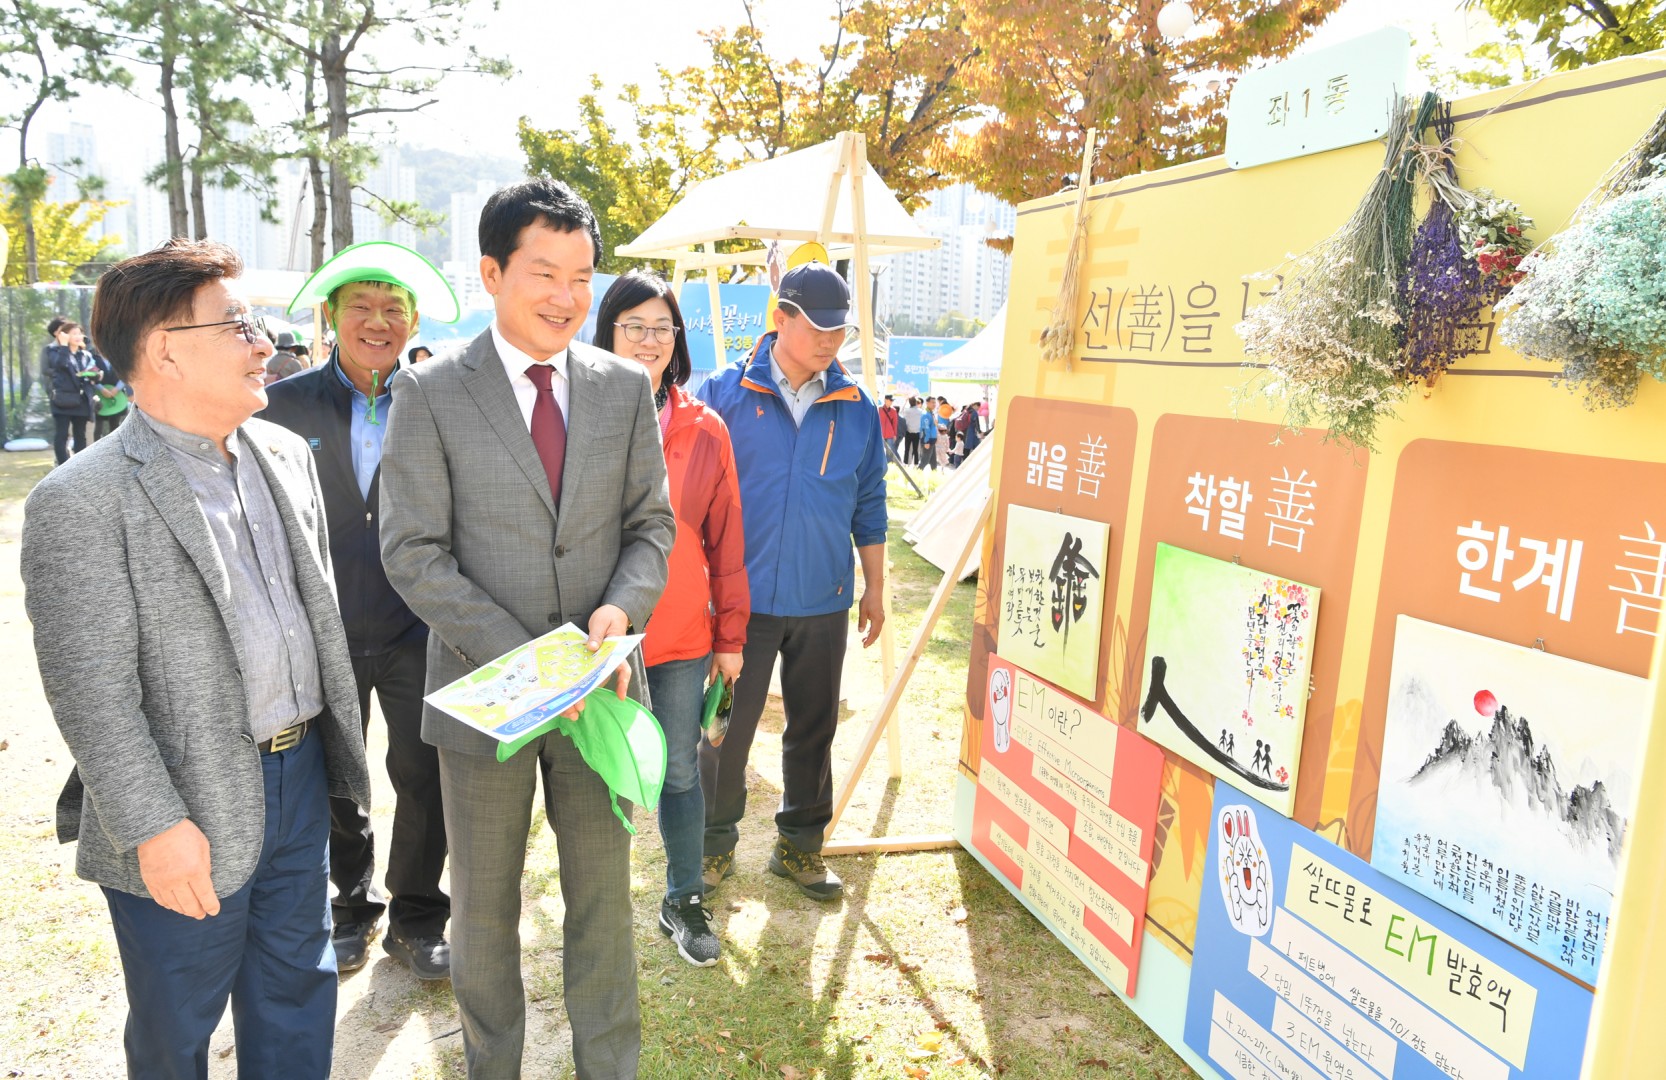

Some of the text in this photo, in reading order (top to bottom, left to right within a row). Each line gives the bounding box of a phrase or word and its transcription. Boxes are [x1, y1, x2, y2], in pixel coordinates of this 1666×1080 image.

[1026, 432, 1109, 500] 맑을 善
[1184, 465, 1318, 553] 착할 善
[1456, 519, 1584, 623] 한계
[1298, 951, 1337, 988] 페트병에
[1302, 860, 1513, 1034] 쌀뜨물로 EM 발효액
[1299, 1032, 1320, 1061] EM
